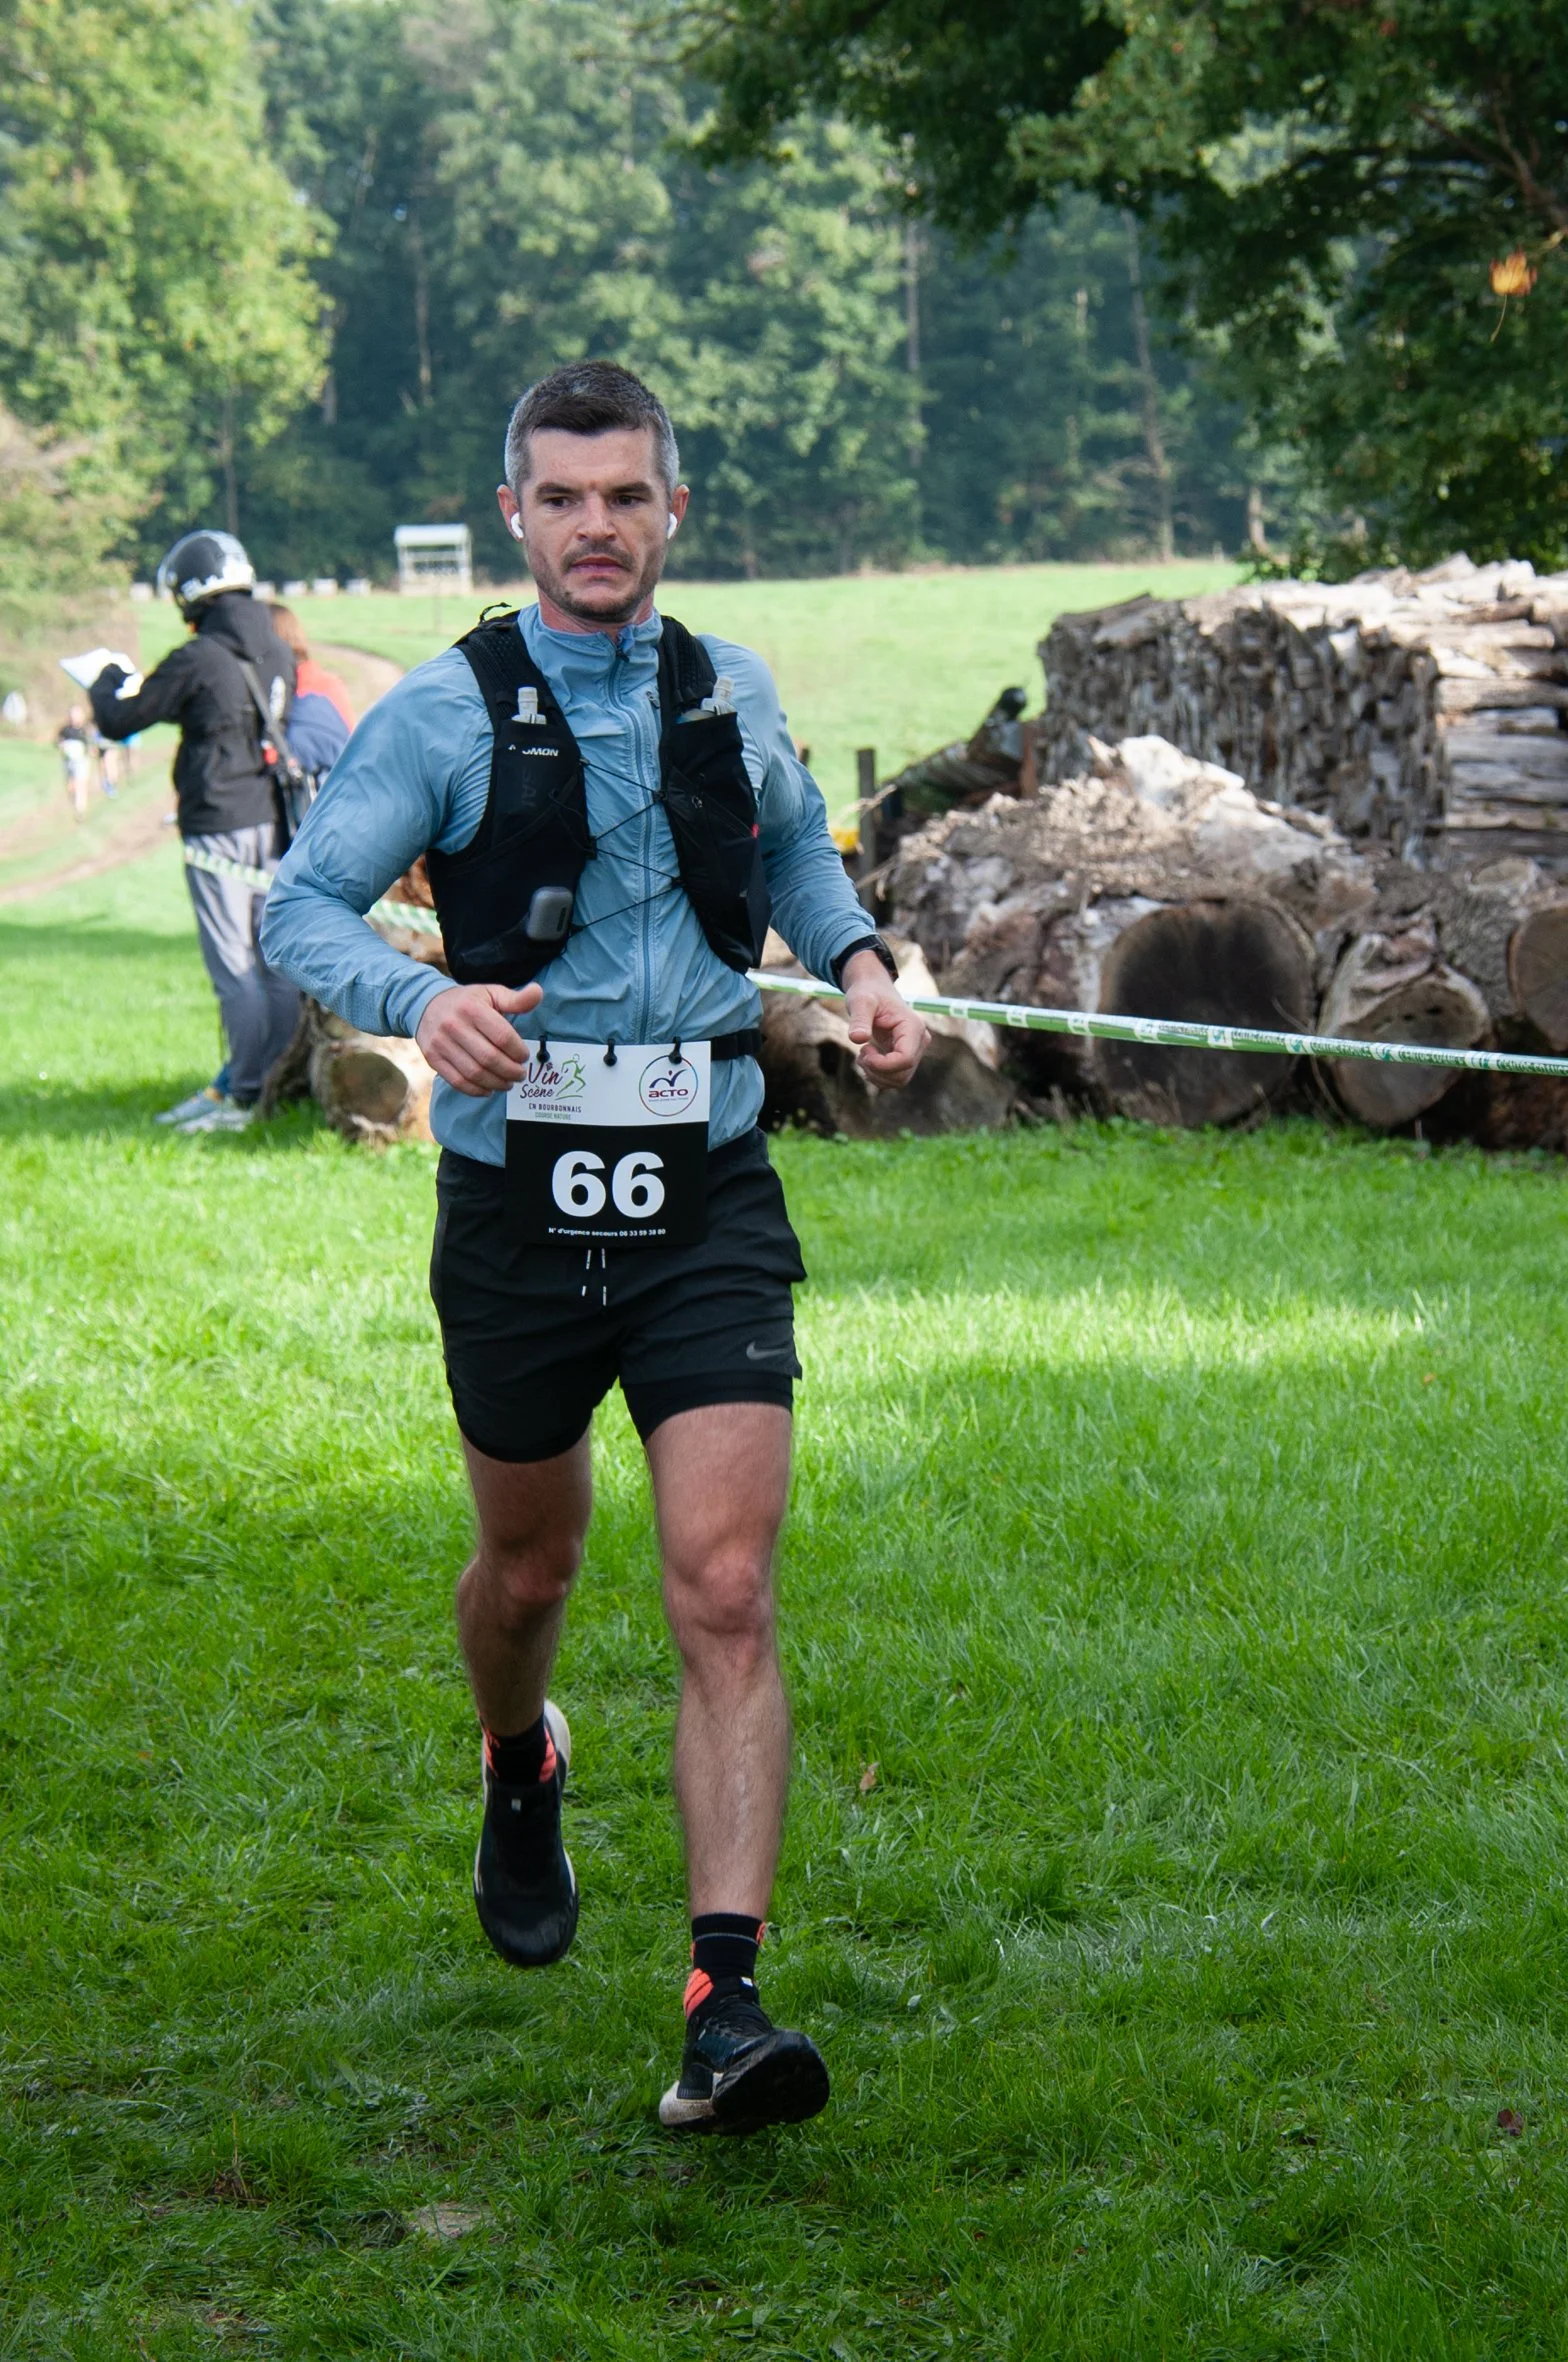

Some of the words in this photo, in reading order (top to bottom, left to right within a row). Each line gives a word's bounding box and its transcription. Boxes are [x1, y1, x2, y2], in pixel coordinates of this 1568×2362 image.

[520, 1083, 554, 1099] Scène
[528, 1102, 537, 1110] EN
[538, 1103, 582, 1113] BOURBONNAIS
[552, 1151, 665, 1217] 66
